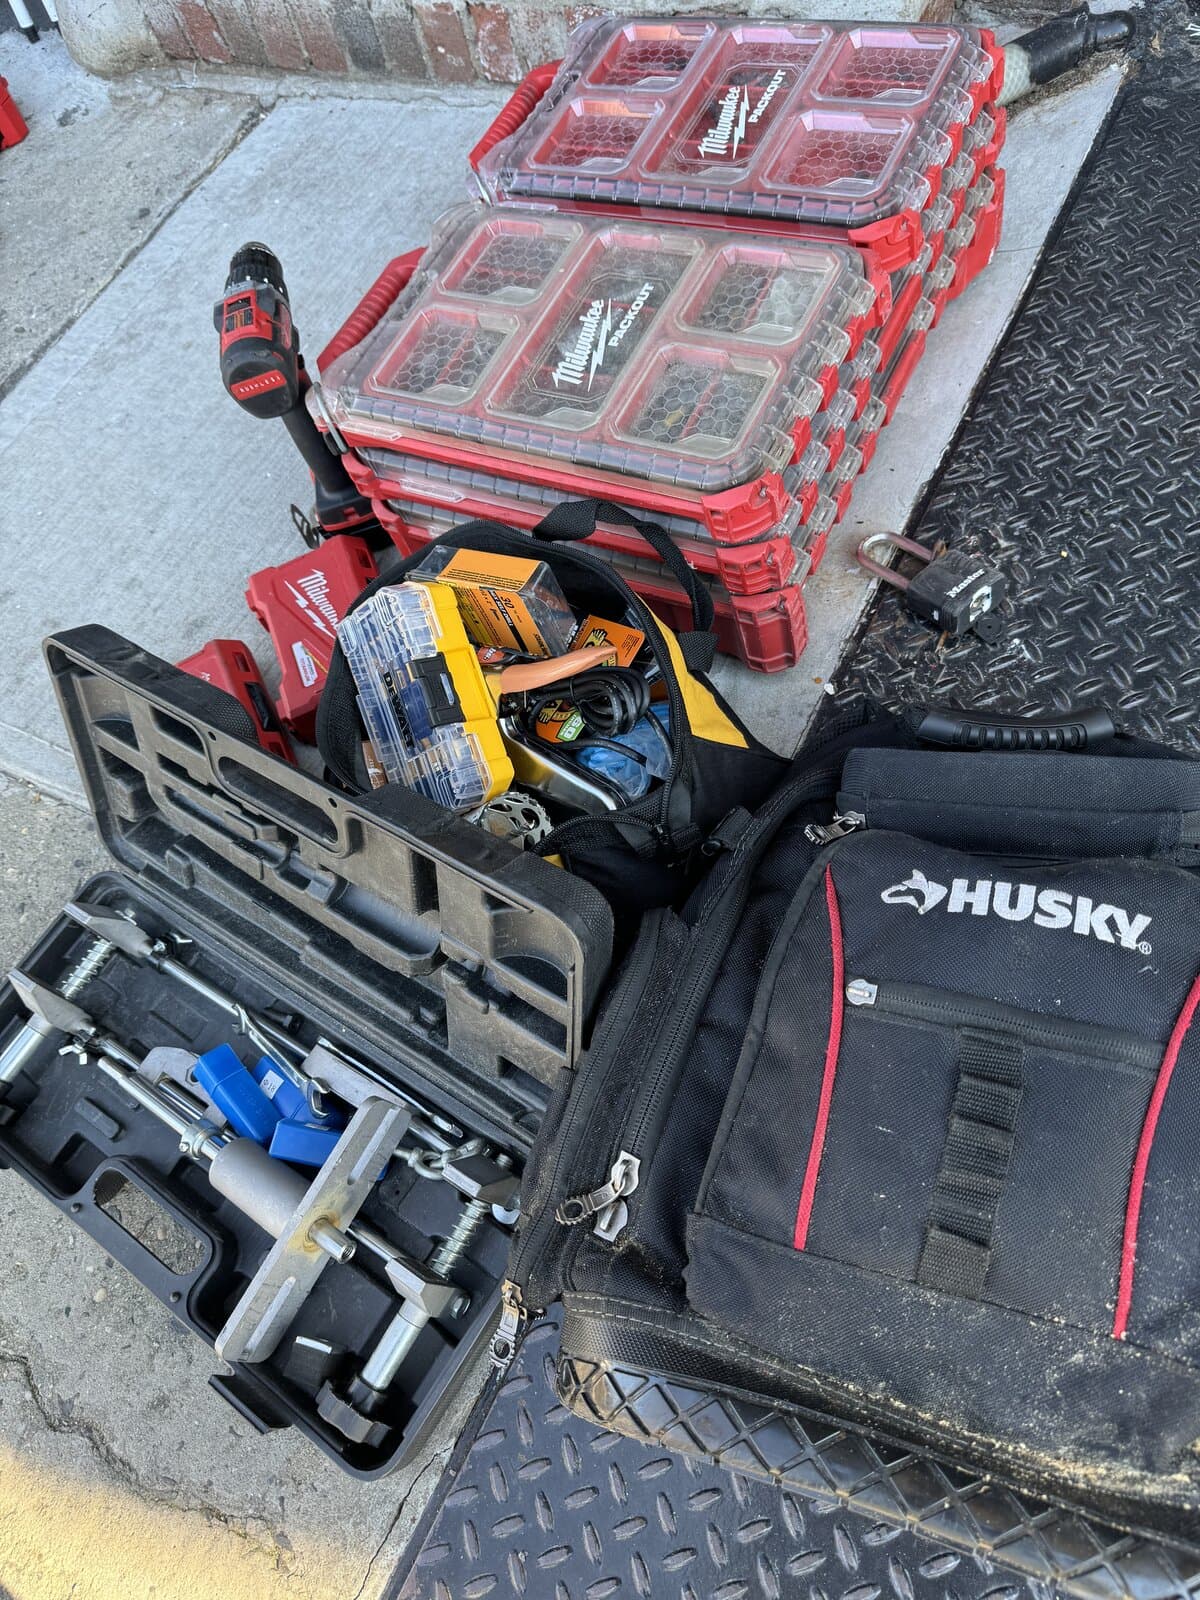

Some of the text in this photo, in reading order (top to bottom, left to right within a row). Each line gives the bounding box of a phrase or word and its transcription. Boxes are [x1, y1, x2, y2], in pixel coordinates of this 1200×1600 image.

[697, 85, 740, 159] Milwaukee
[748, 69, 786, 123] PACKOUT
[552, 299, 604, 388] Milwaukee
[607, 282, 654, 347] PACKOUT
[944, 568, 985, 598] Master
